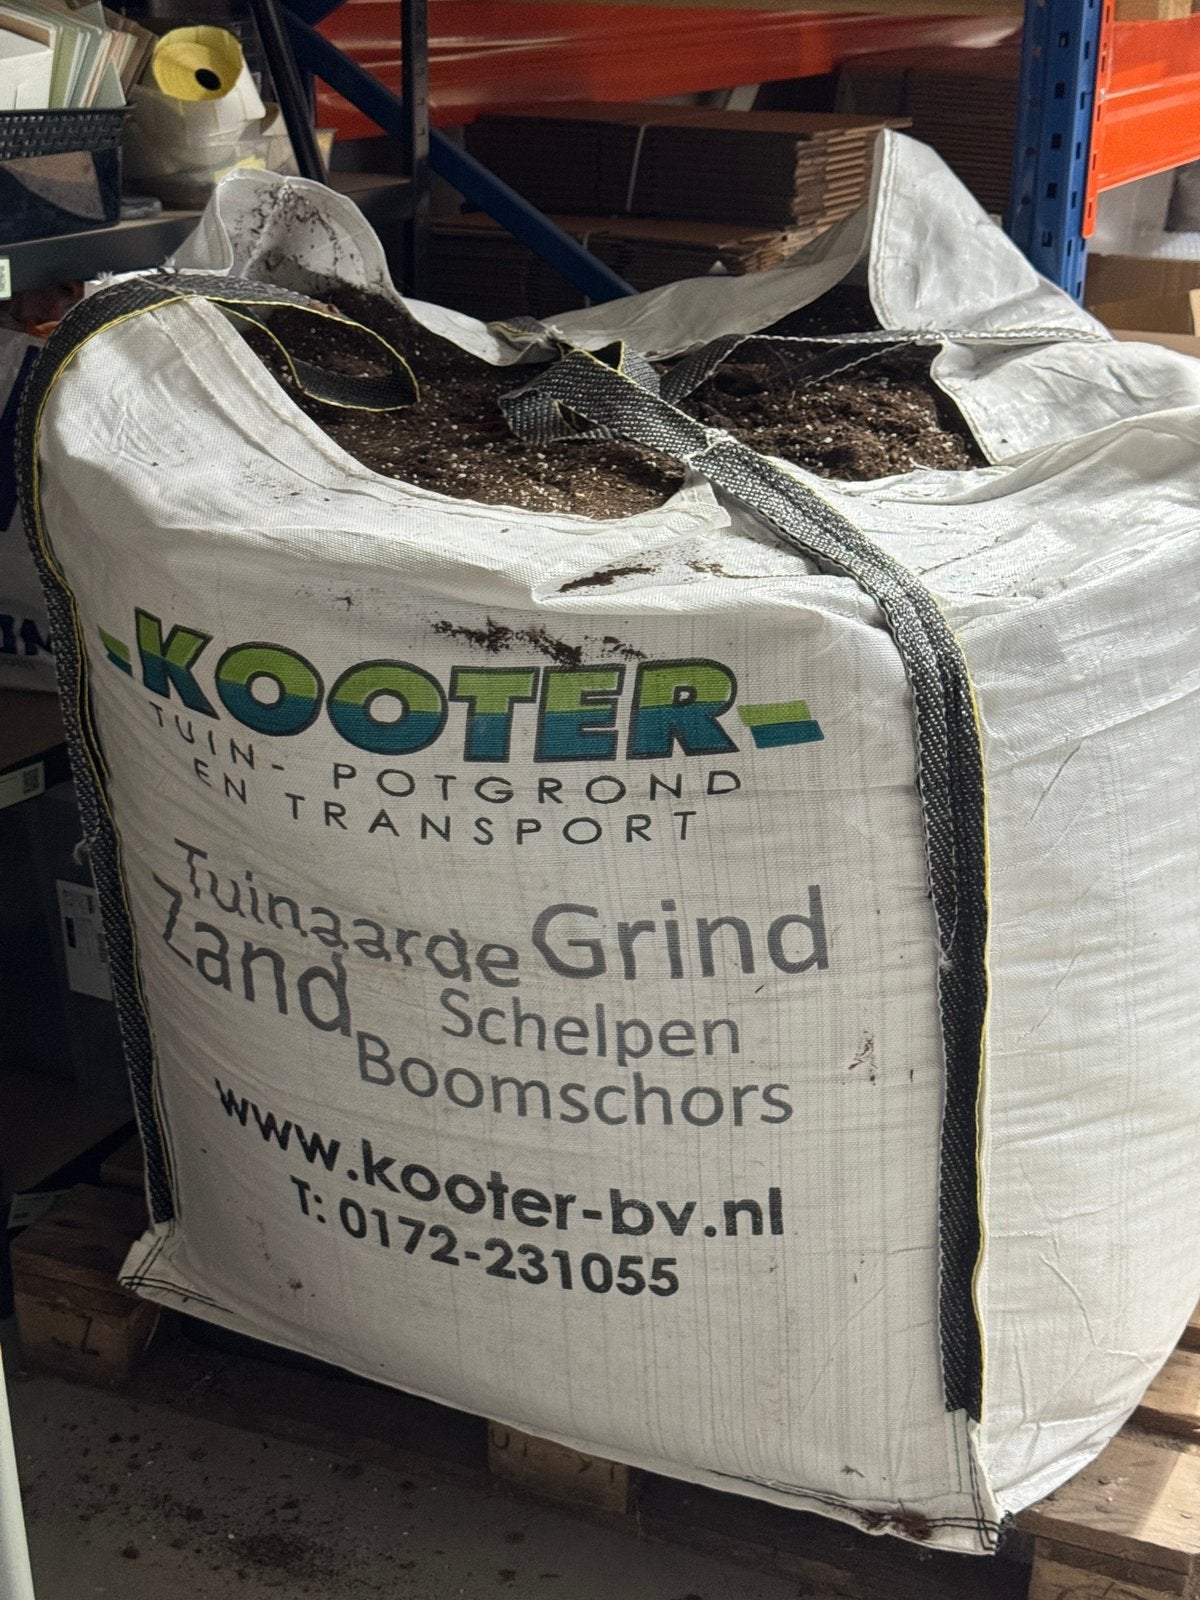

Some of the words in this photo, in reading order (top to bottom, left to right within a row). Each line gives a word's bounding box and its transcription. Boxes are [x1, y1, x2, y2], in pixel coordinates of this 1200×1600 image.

[134, 606, 741, 763] KOOTER
[149, 700, 285, 770] TUIN-
[333, 762, 741, 804] POTGROND
[194, 757, 247, 804] EN
[285, 792, 697, 846] TRANSPORT
[152, 871, 352, 1038] Zand
[174, 837, 520, 988] Tuinaarde
[531, 884, 829, 980] Grind
[356, 1029, 793, 1127] Boomschors
[440, 987, 740, 1067] Schelpen
[214, 1076, 784, 1238] www.kooter-bv.nl
[290, 1174, 326, 1224] T:
[338, 1196, 680, 1297] 0172-231055
